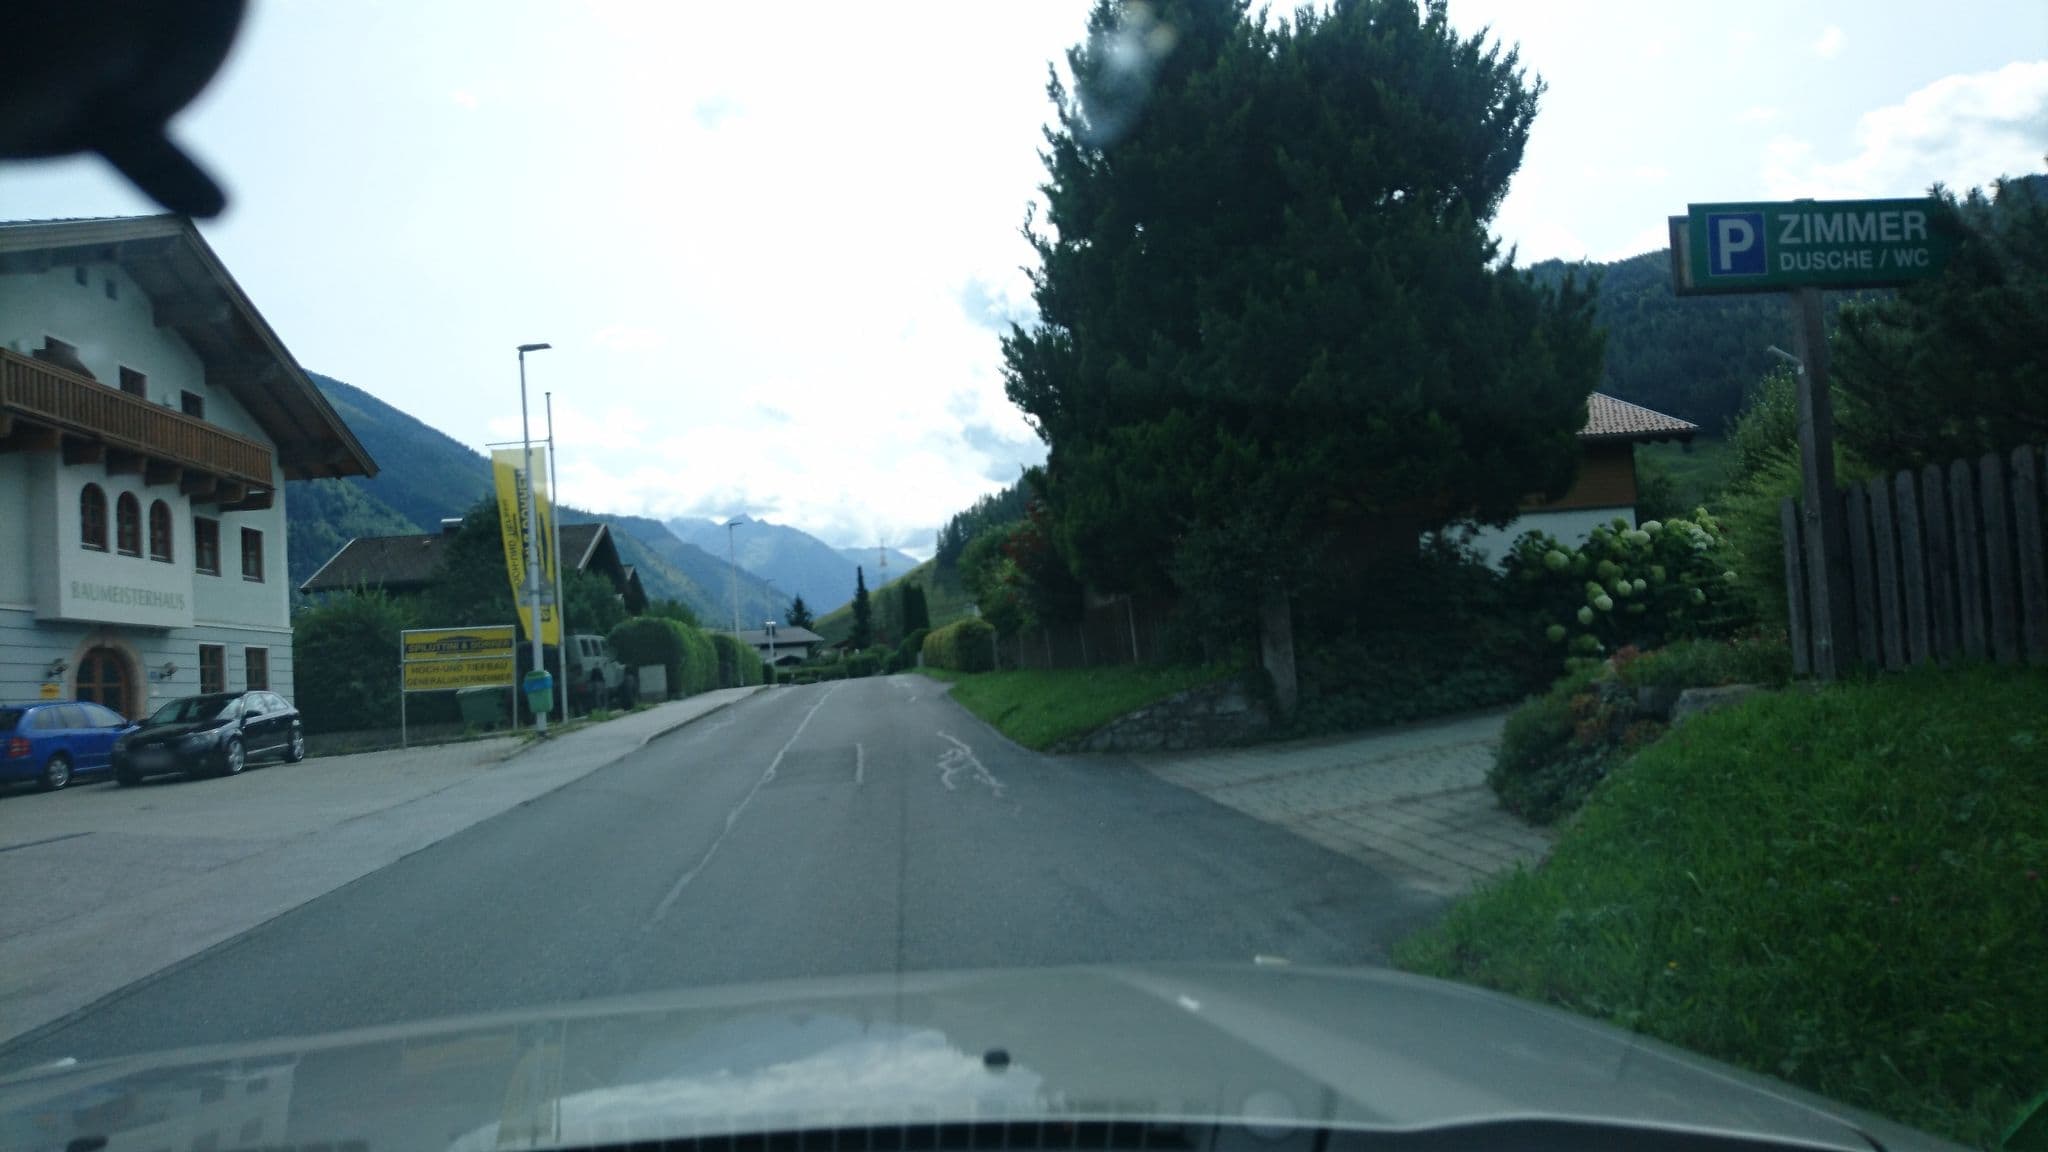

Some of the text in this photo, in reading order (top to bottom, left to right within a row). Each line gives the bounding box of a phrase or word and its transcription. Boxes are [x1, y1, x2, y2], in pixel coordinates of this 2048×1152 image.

[1777, 210, 1928, 244] ZIMMER
[1718, 219, 1755, 270] P
[1780, 250, 1873, 271] DUSCHE
[1894, 248, 1929, 267] WC
[71, 580, 185, 610] BAUMEISTERHAUS
